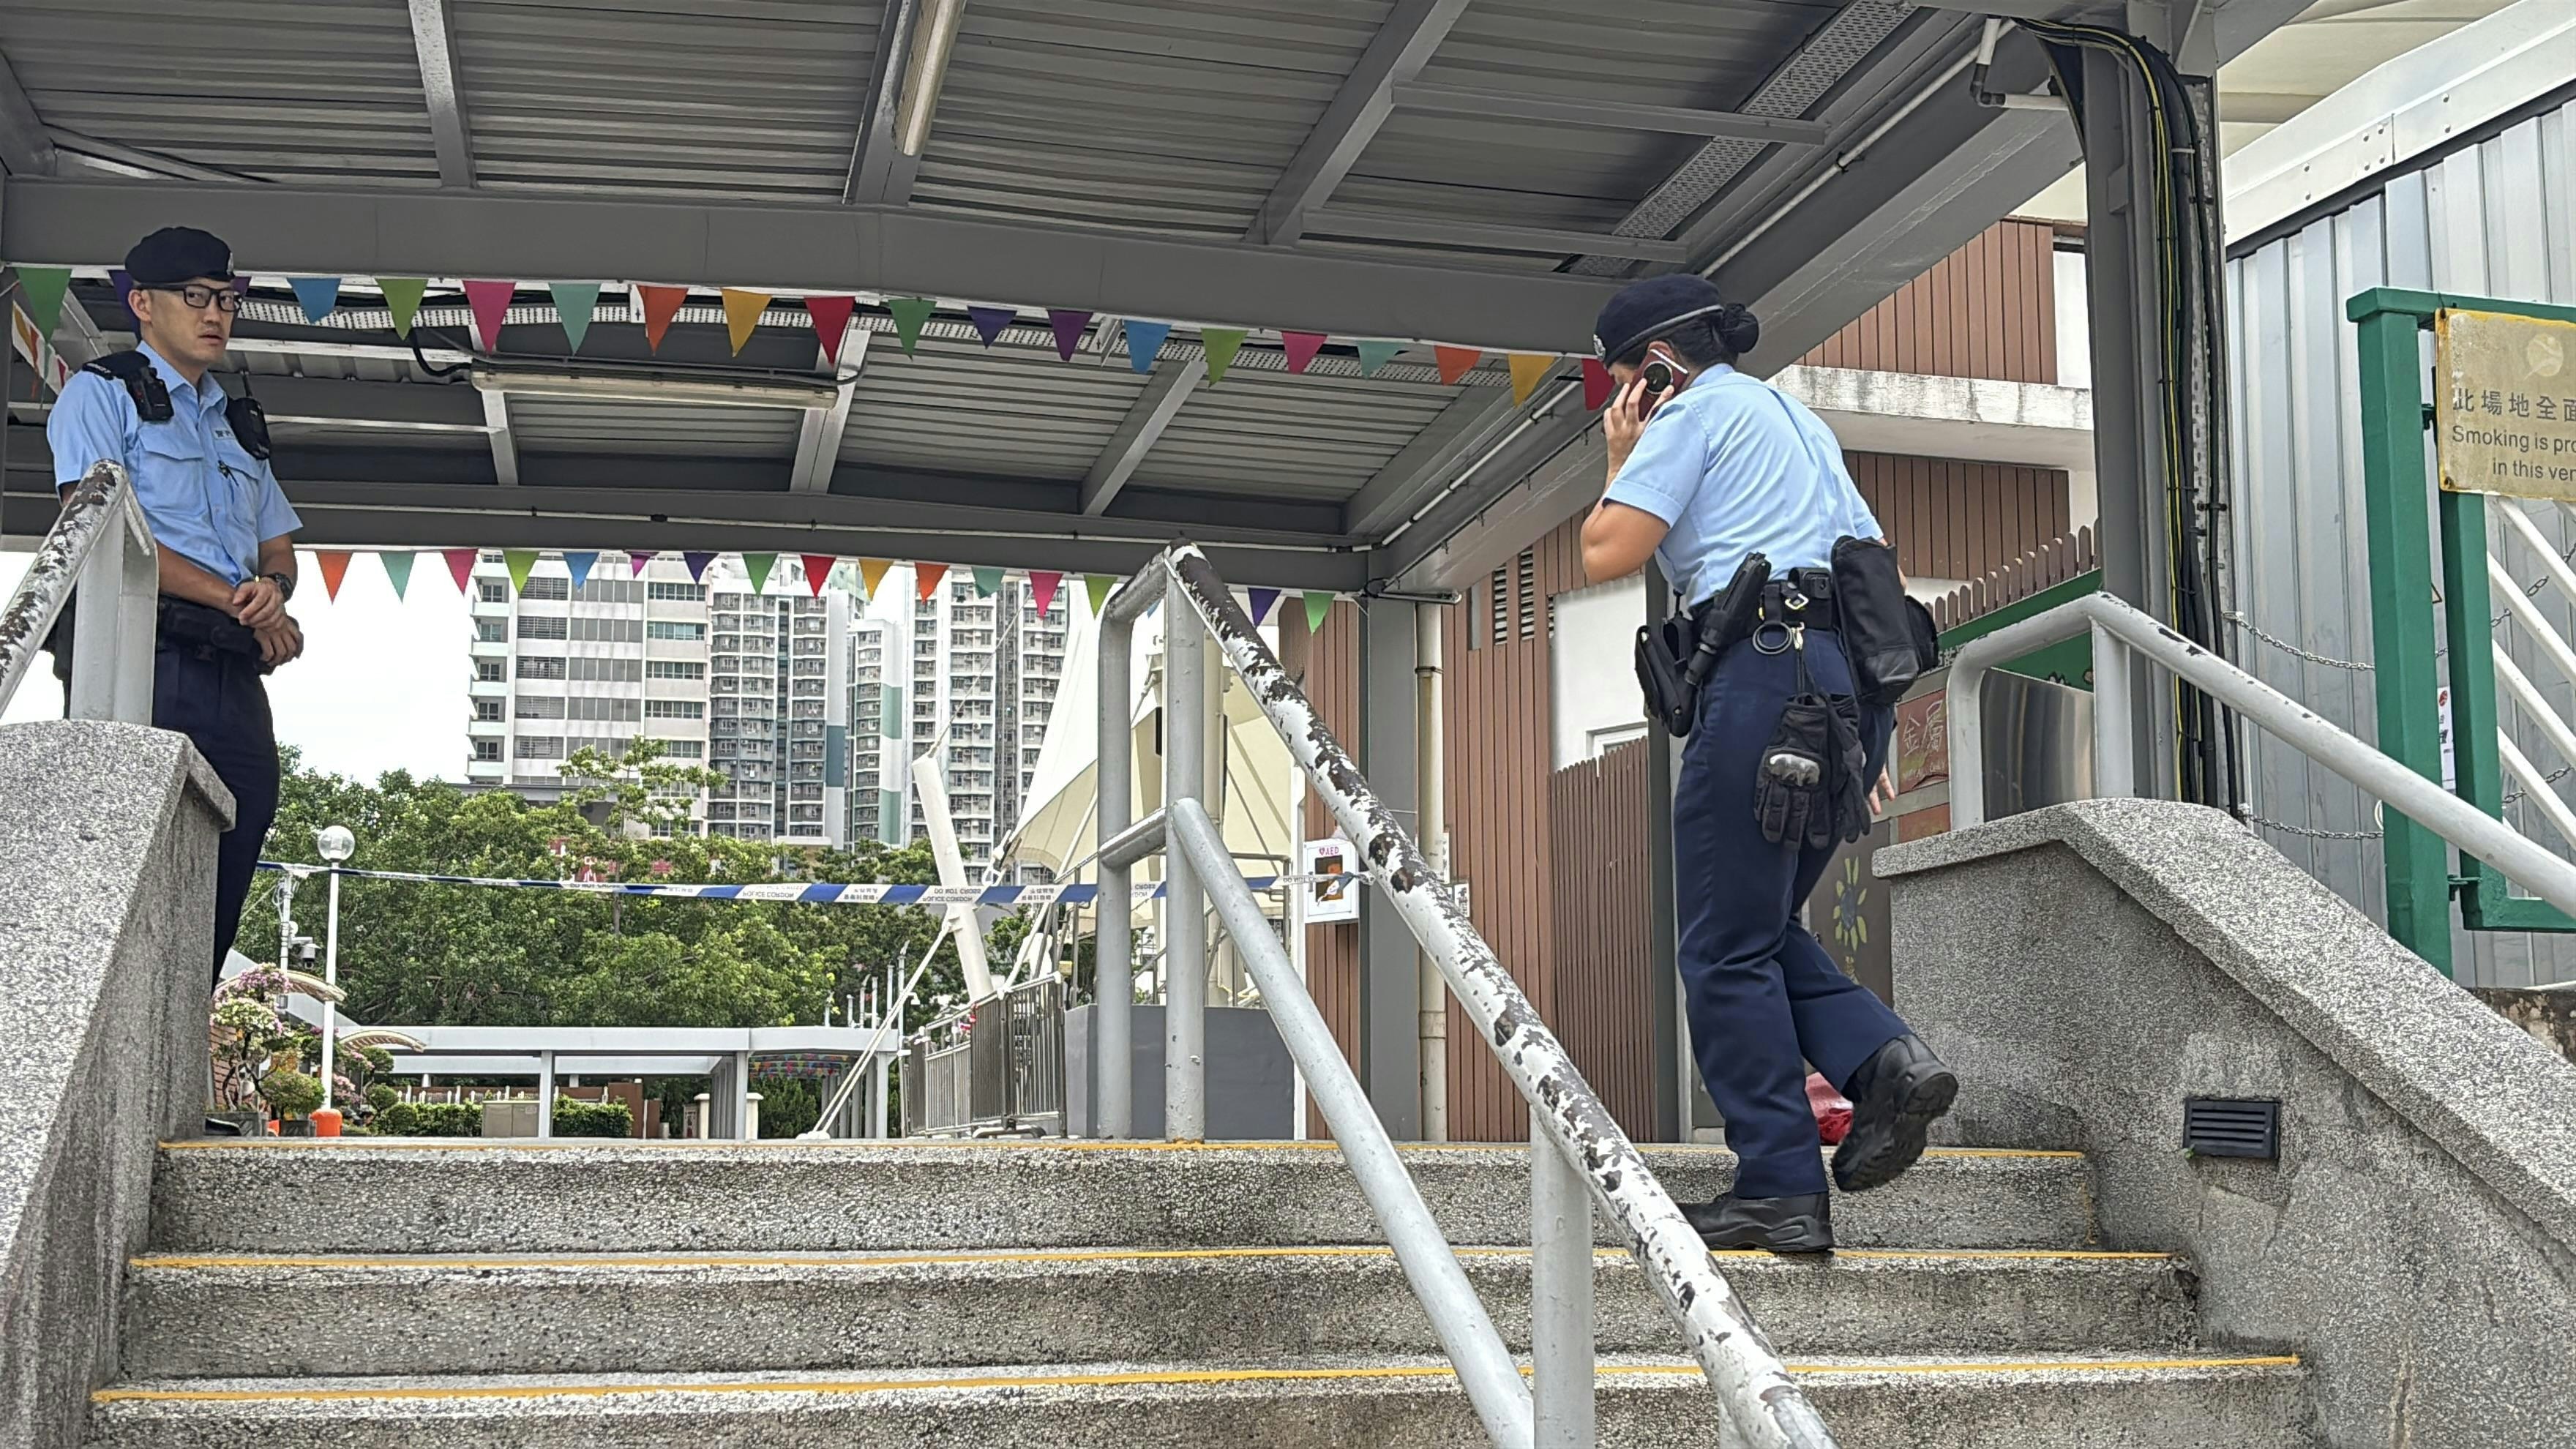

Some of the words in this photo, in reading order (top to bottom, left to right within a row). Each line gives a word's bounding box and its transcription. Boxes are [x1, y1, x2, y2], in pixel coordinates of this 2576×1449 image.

[2452, 388, 2576, 422] 此場地全面
[2452, 425, 2529, 452] Smoking
[2534, 432, 2548, 450] is
[2493, 457, 2507, 476] in
[2513, 460, 2544, 479] this
[1325, 847, 1339, 855] AED
